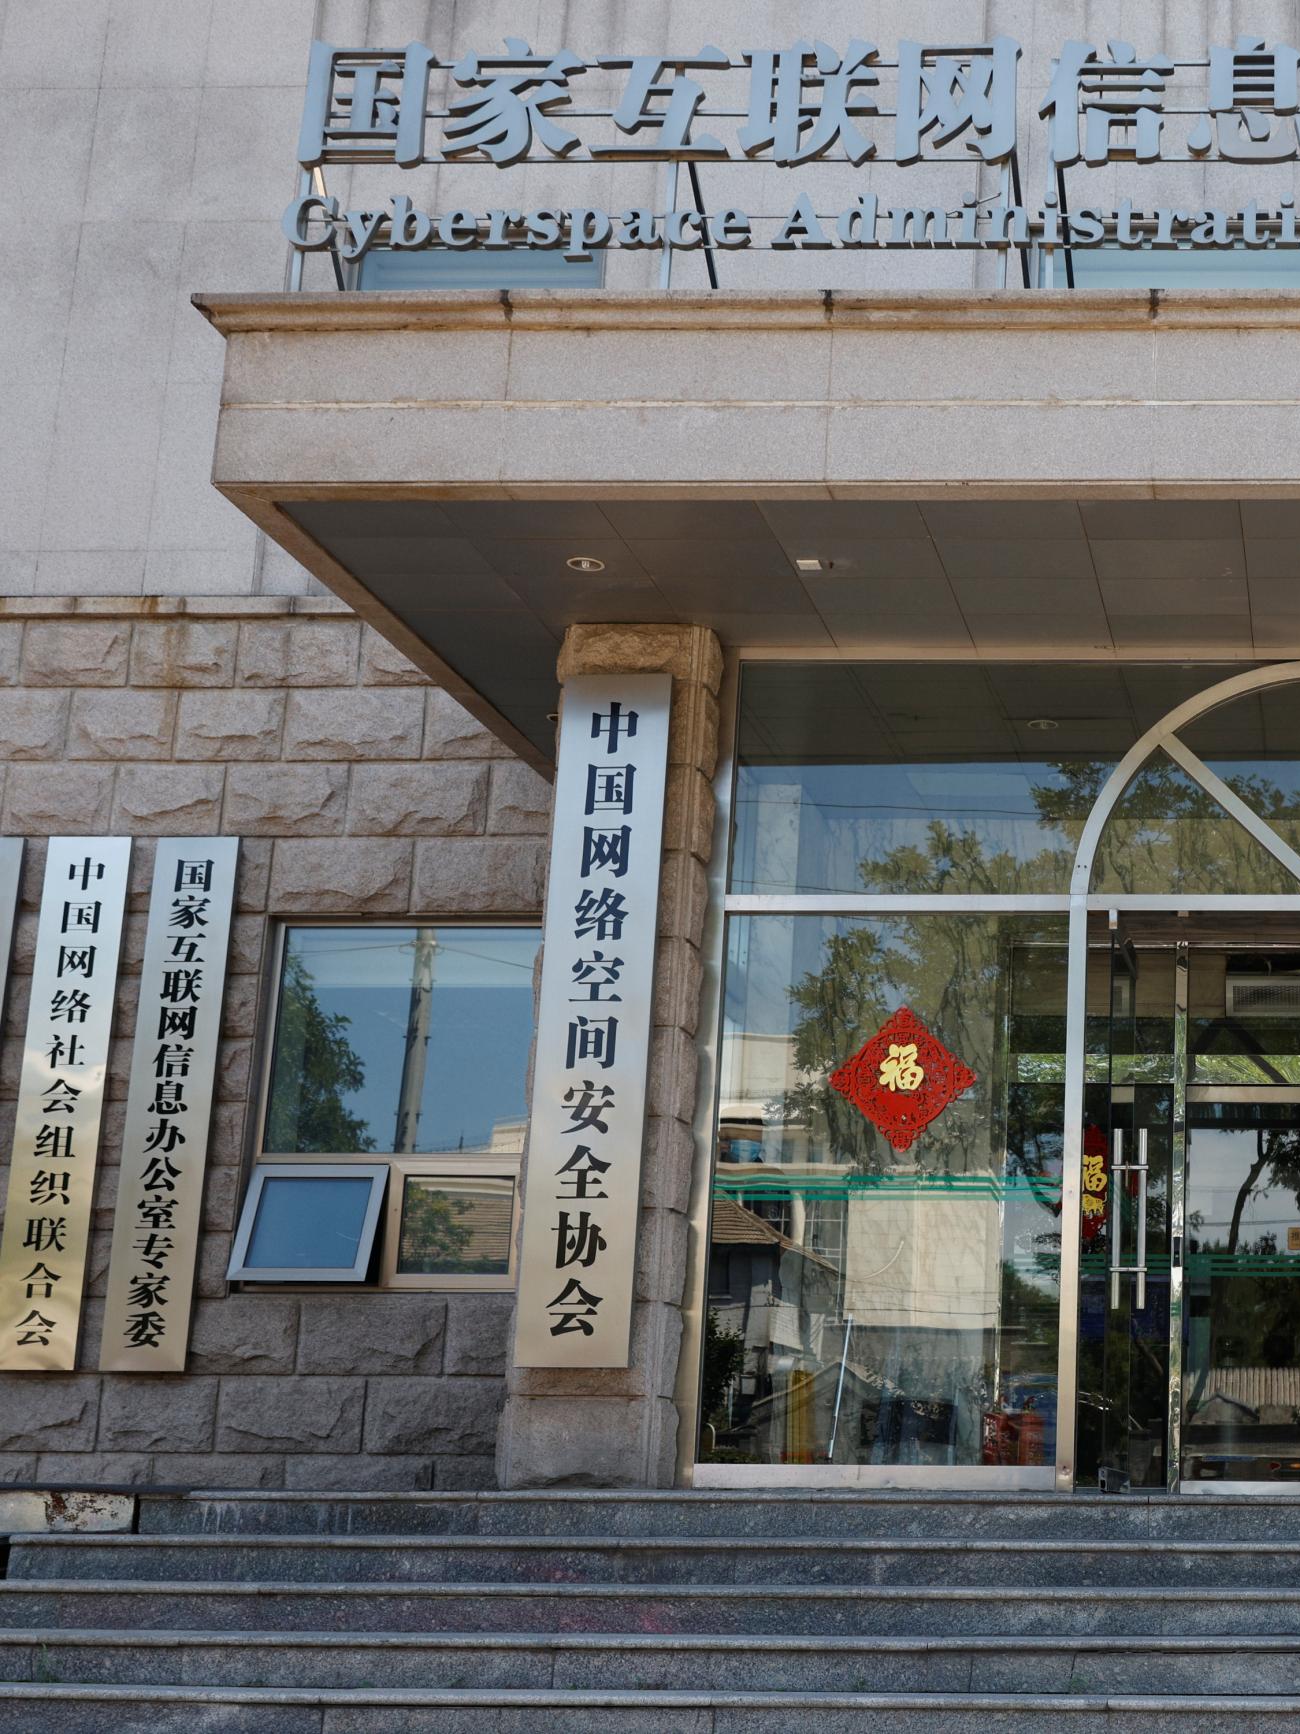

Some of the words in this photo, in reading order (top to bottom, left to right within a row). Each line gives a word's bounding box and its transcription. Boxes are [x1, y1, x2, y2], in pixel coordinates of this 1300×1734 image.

[281, 195, 751, 262] Cyberspace
[15, 857, 105, 1347] 中国网络社会组织联合会
[123, 859, 214, 1349] 国家互联网信息办公室专家委
[545, 701, 639, 1337] 中国网络空间安全协会
[879, 1043, 924, 1091] 福
[1082, 1154, 1107, 1192] 福
